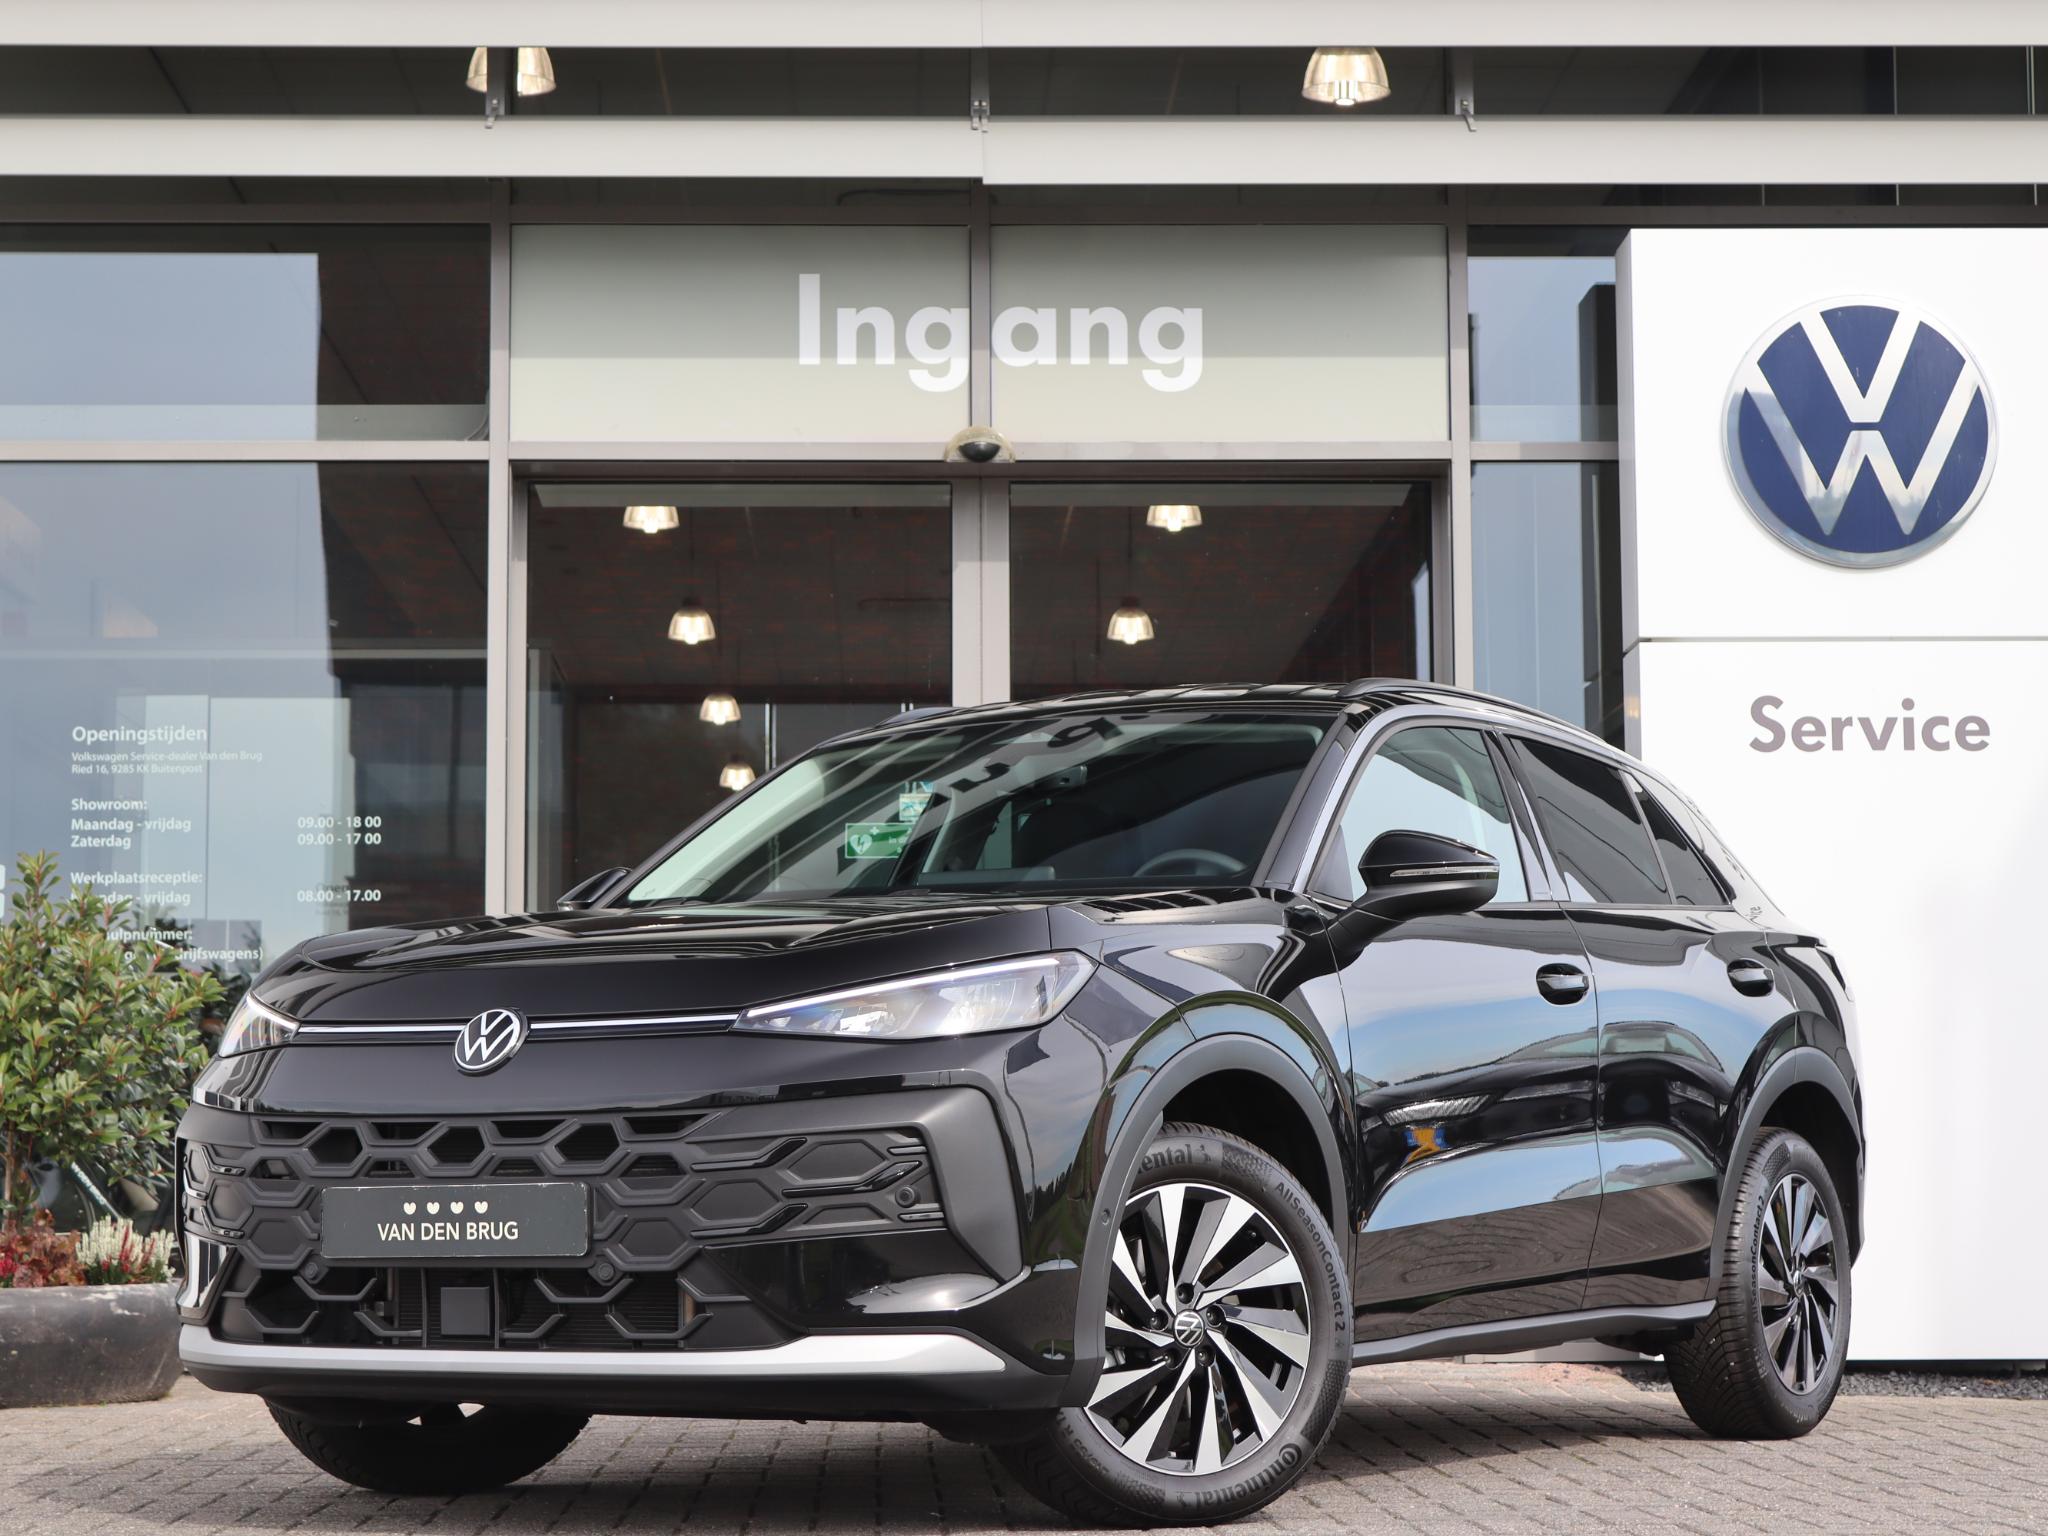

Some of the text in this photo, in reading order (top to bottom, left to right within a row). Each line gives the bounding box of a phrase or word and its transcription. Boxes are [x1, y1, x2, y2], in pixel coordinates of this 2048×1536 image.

[1749, 695, 1990, 753] Service
[72, 726, 207, 745] Openingstijden
[72, 751, 128, 762] Volkswagen
[239, 750, 262, 762] Brug
[72, 764, 92, 774] Ried
[96, 765, 109, 775] 16,
[151, 764, 202, 775] Buitenpost
[71, 799, 147, 811] Showroom:
[71, 819, 133, 833] Maandag
[145, 818, 191, 832] vrijdag
[297, 816, 334, 828] 09.00
[71, 835, 131, 850] Zaterdag
[297, 833, 334, 845] 09.00
[71, 871, 202, 886] Werkplaatsreceptie:
[144, 891, 191, 905] vrijdag
[297, 890, 334, 902] 08.00
[345, 889, 382, 902] 17.00
[1138, 1144, 1192, 1174] ental
[378, 1221, 519, 1240] VAN DEN BRUG
[1275, 1182, 1346, 1331] AllSeasonContact 2
[1195, 1443, 1303, 1508] Continental
